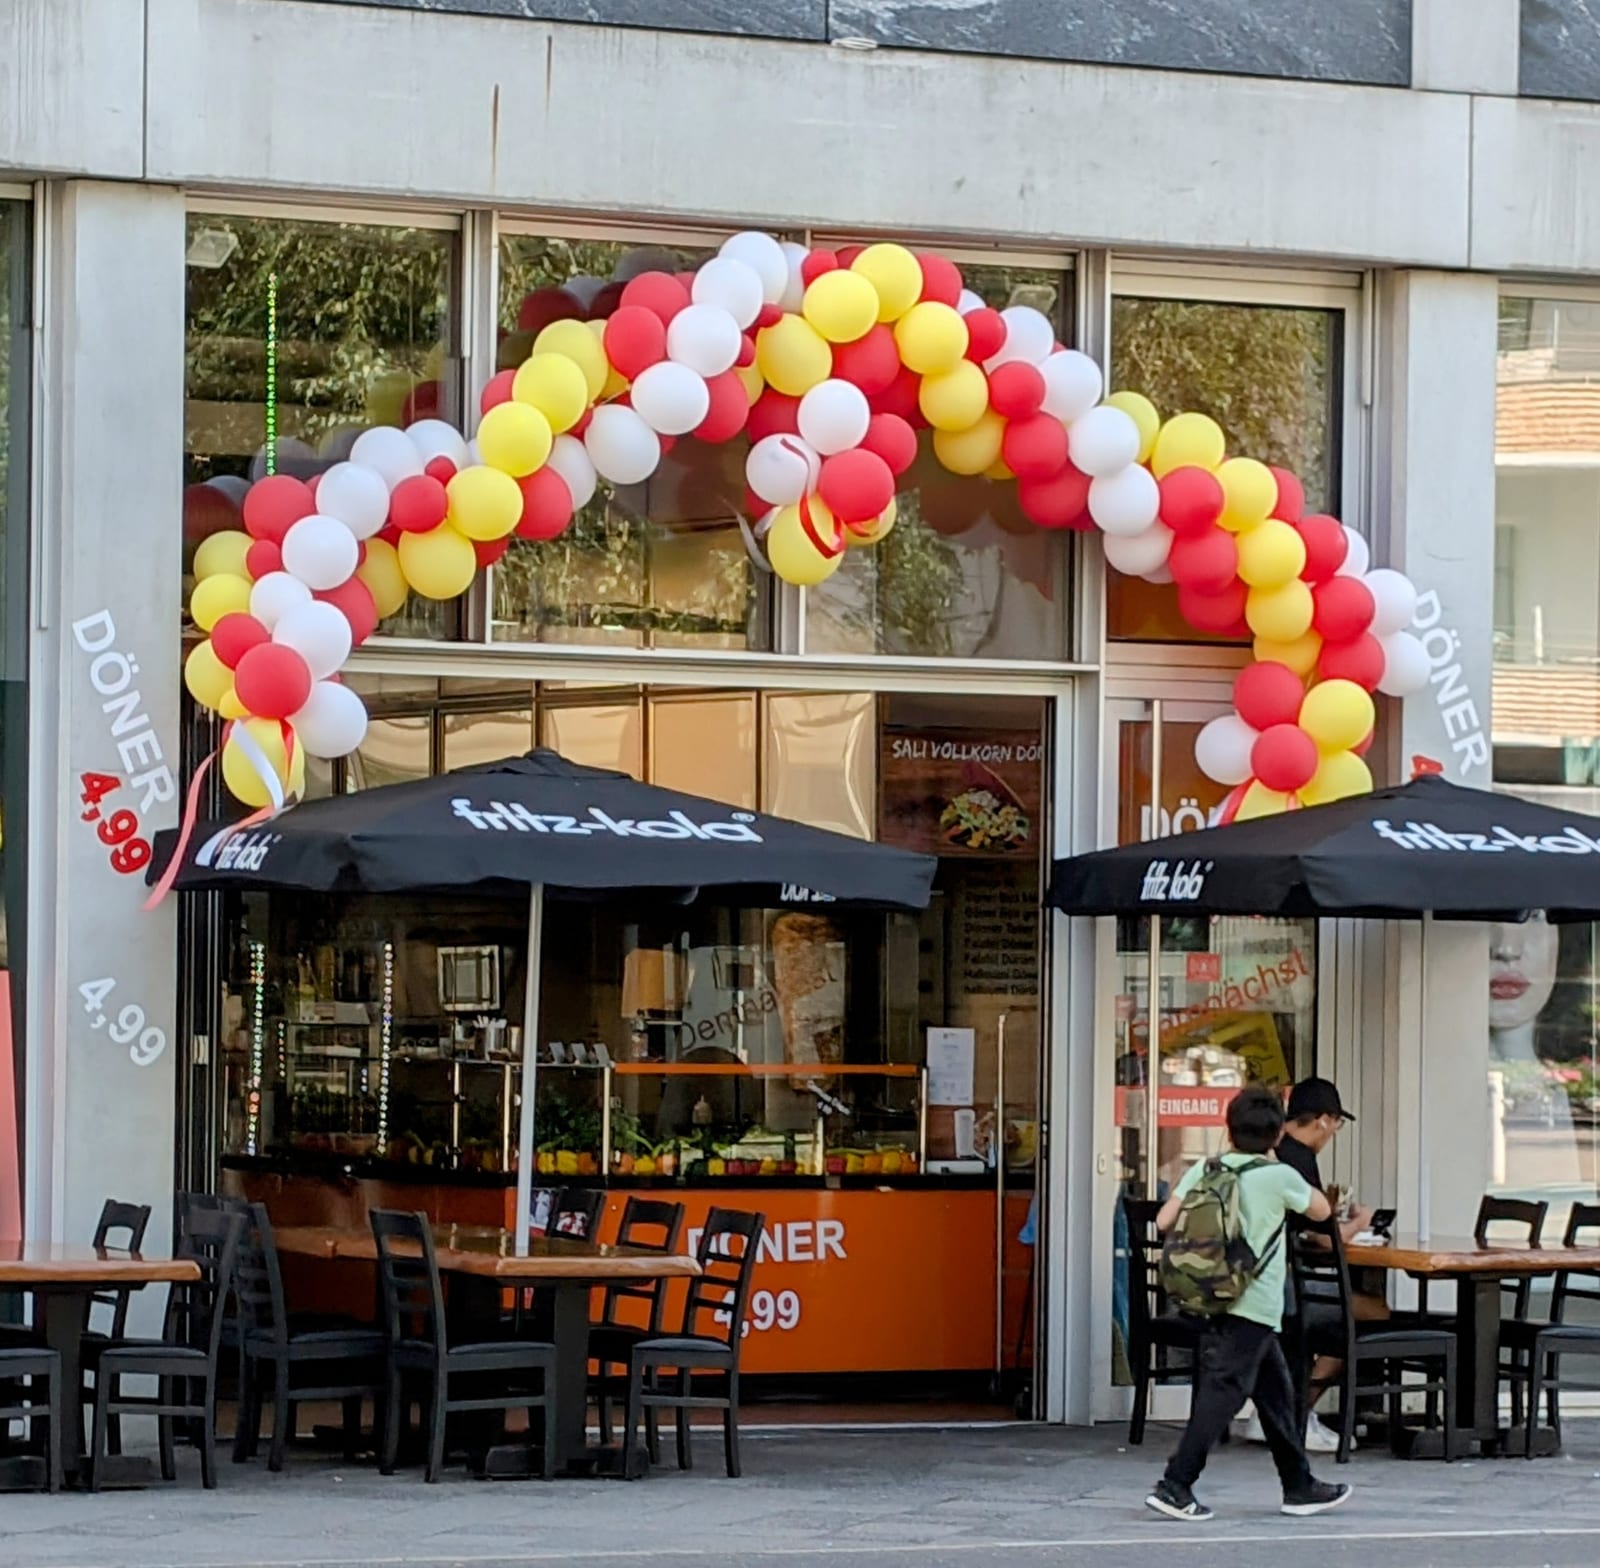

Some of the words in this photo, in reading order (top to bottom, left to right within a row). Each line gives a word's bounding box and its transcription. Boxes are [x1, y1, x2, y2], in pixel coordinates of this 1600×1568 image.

[1411, 589, 1488, 776] DÖNER
[72, 608, 176, 814] DÖNER
[892, 739, 927, 761] SALI
[931, 742, 1012, 763] VOLLKORN
[80, 771, 152, 875] 4,99
[1140, 798, 1217, 842] DÖ
[1373, 820, 1600, 854] fritz-kol
[78, 977, 167, 1066] 4,99
[1159, 1098, 1219, 1116] EINGANG
[713, 1289, 800, 1338] 4,99
